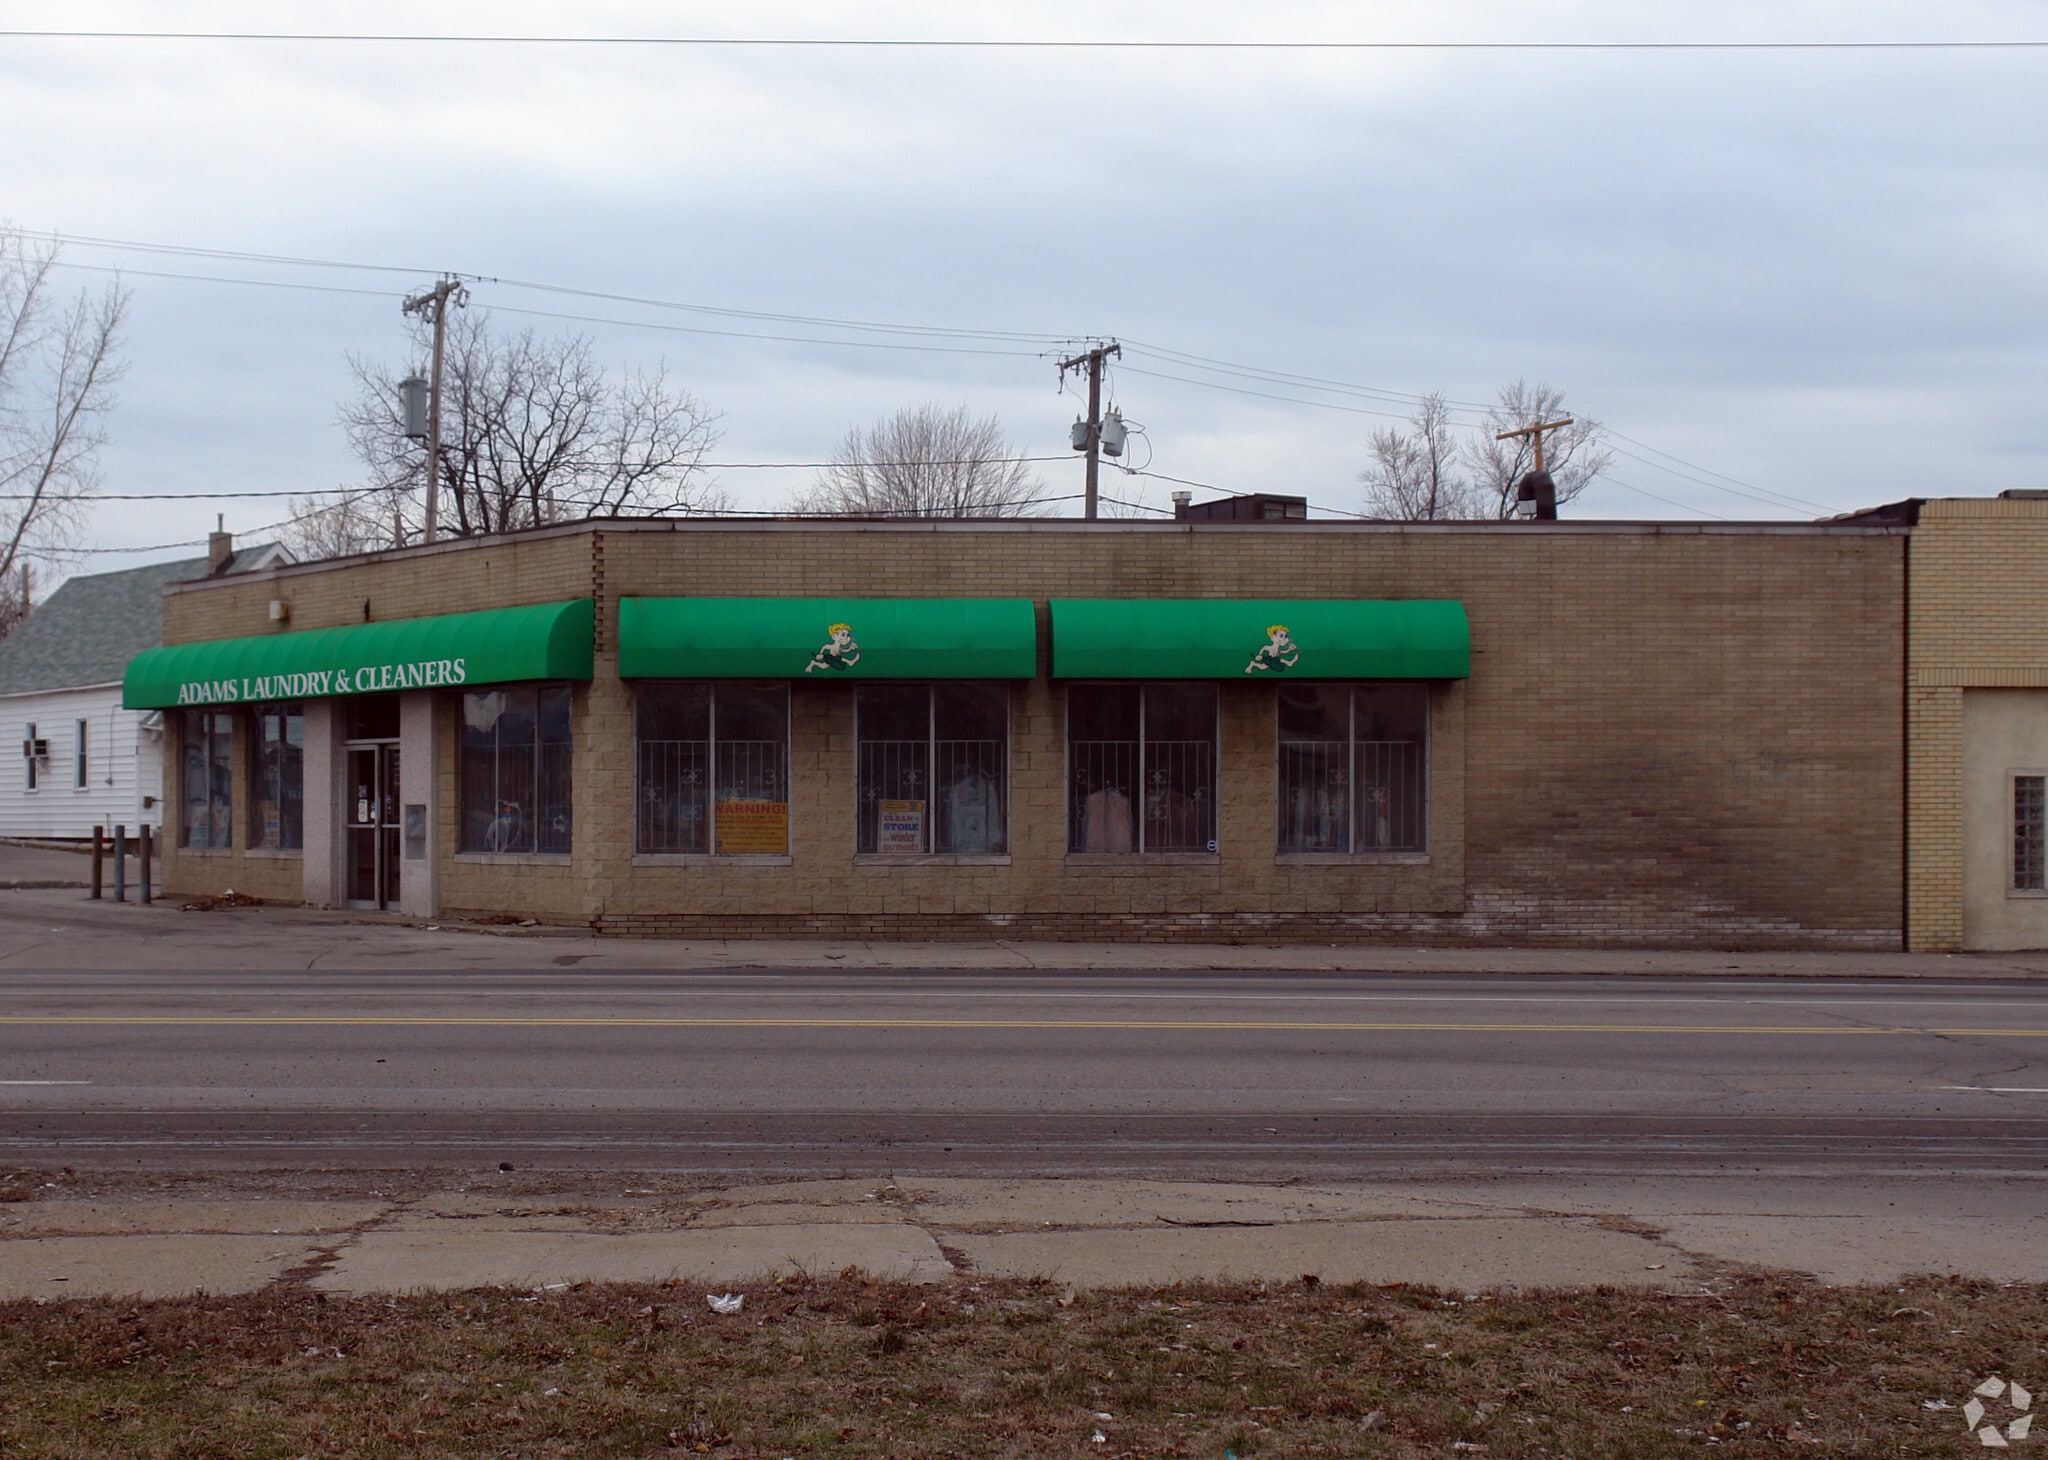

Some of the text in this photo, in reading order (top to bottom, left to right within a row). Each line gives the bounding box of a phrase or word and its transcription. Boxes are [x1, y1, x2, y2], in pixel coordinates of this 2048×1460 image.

[177, 658, 466, 704] ADAMS LAUNDRY & CLEANERS
[883, 823, 919, 831] STORE
